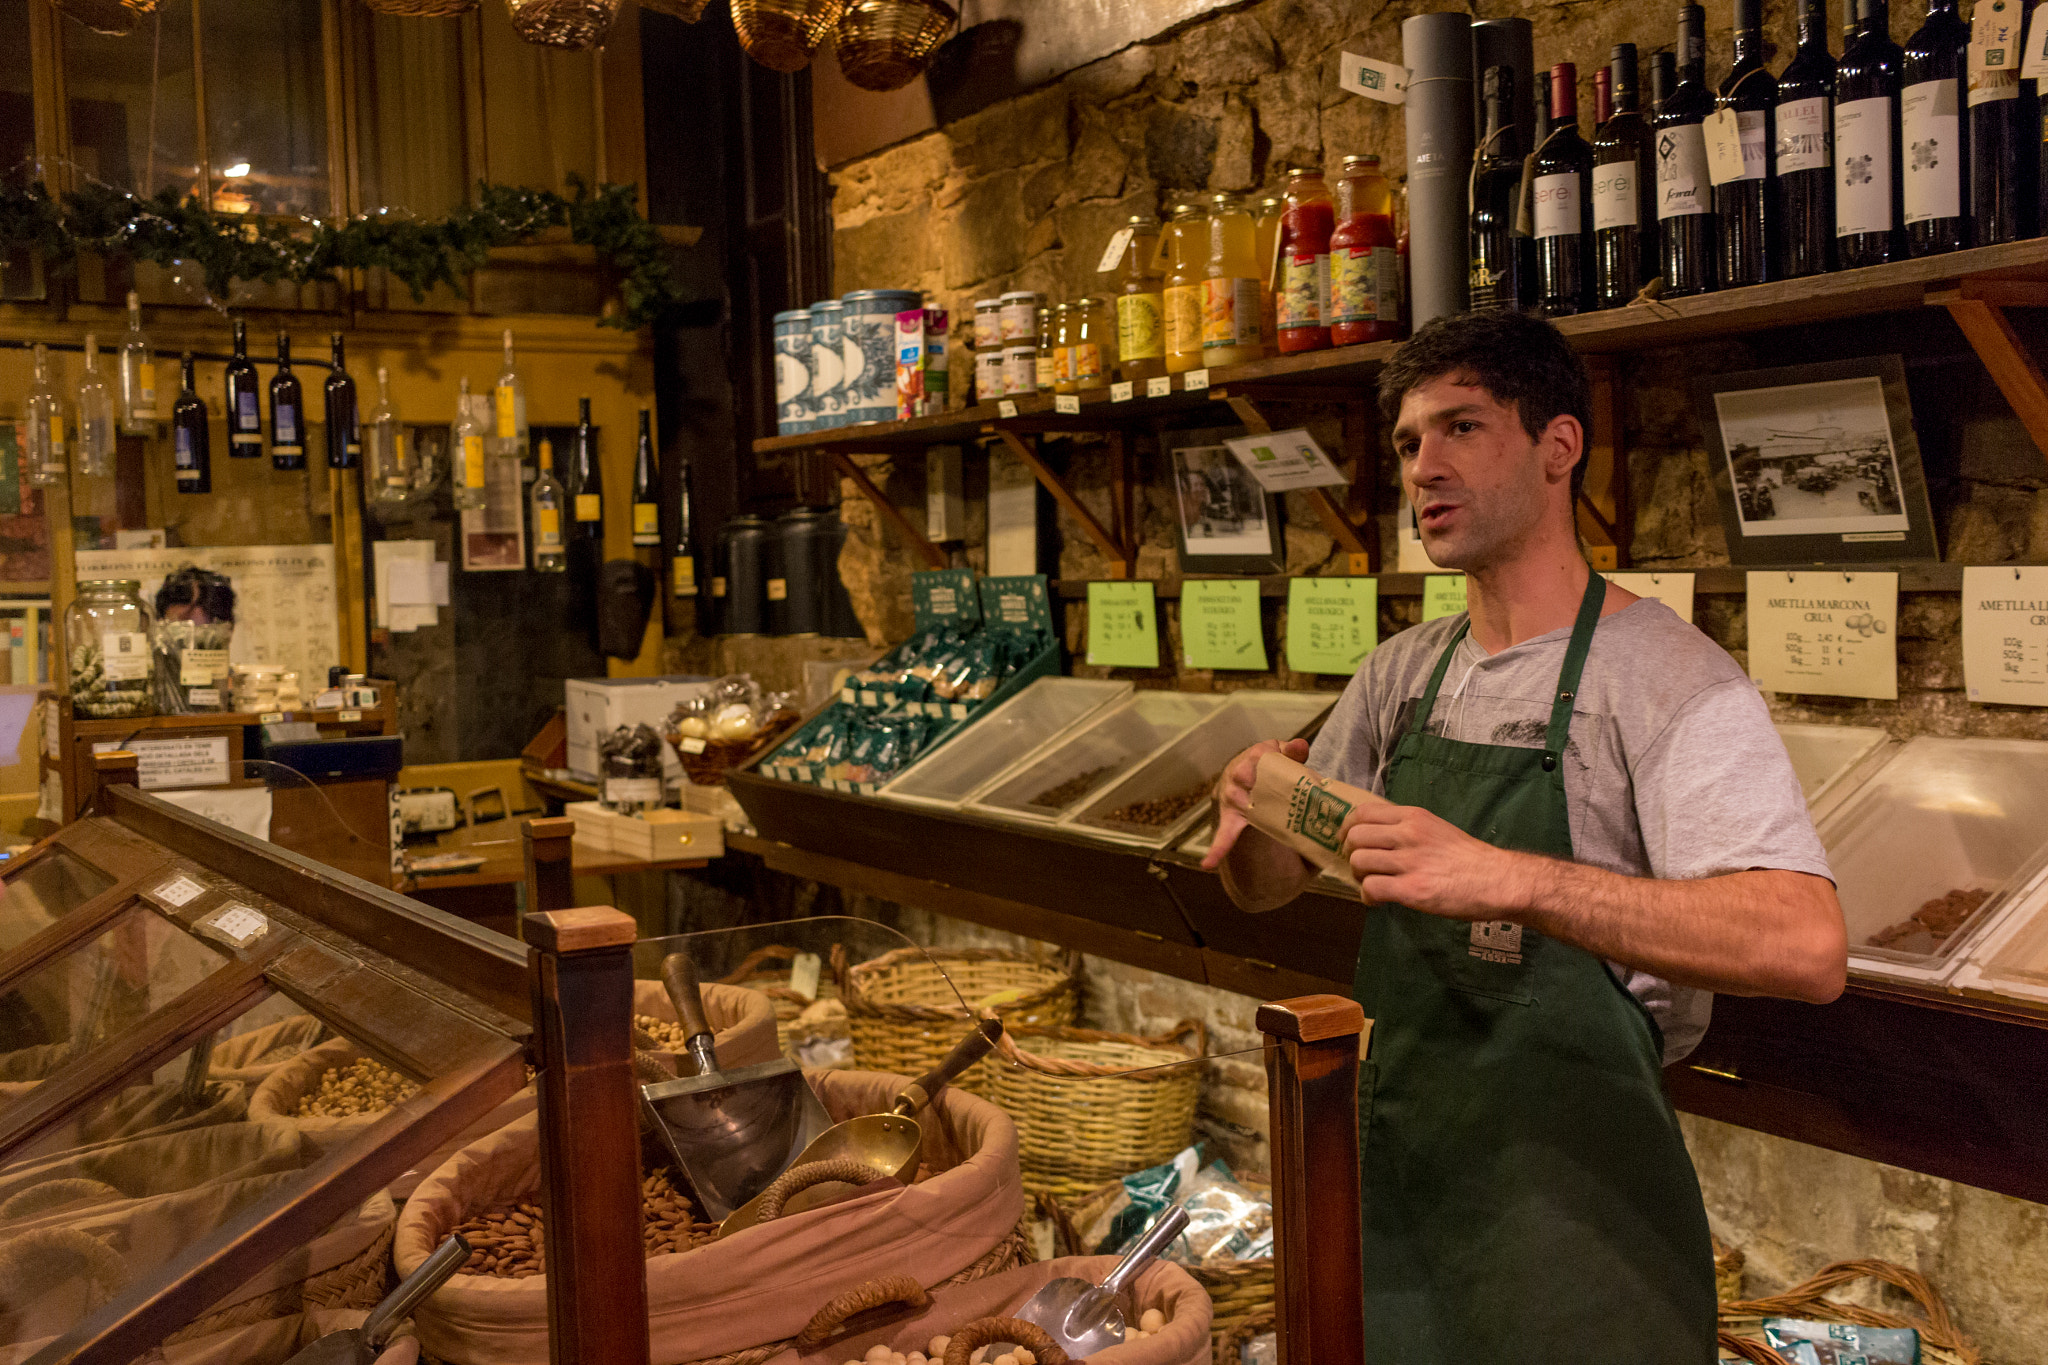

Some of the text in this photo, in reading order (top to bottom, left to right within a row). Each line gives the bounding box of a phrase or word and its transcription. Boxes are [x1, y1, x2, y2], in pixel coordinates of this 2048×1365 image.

[1767, 599, 1870, 610] AMETLLA MARCONA
[1978, 600, 2036, 611] AMETLLA
[1804, 612, 1833, 622] CRUA
